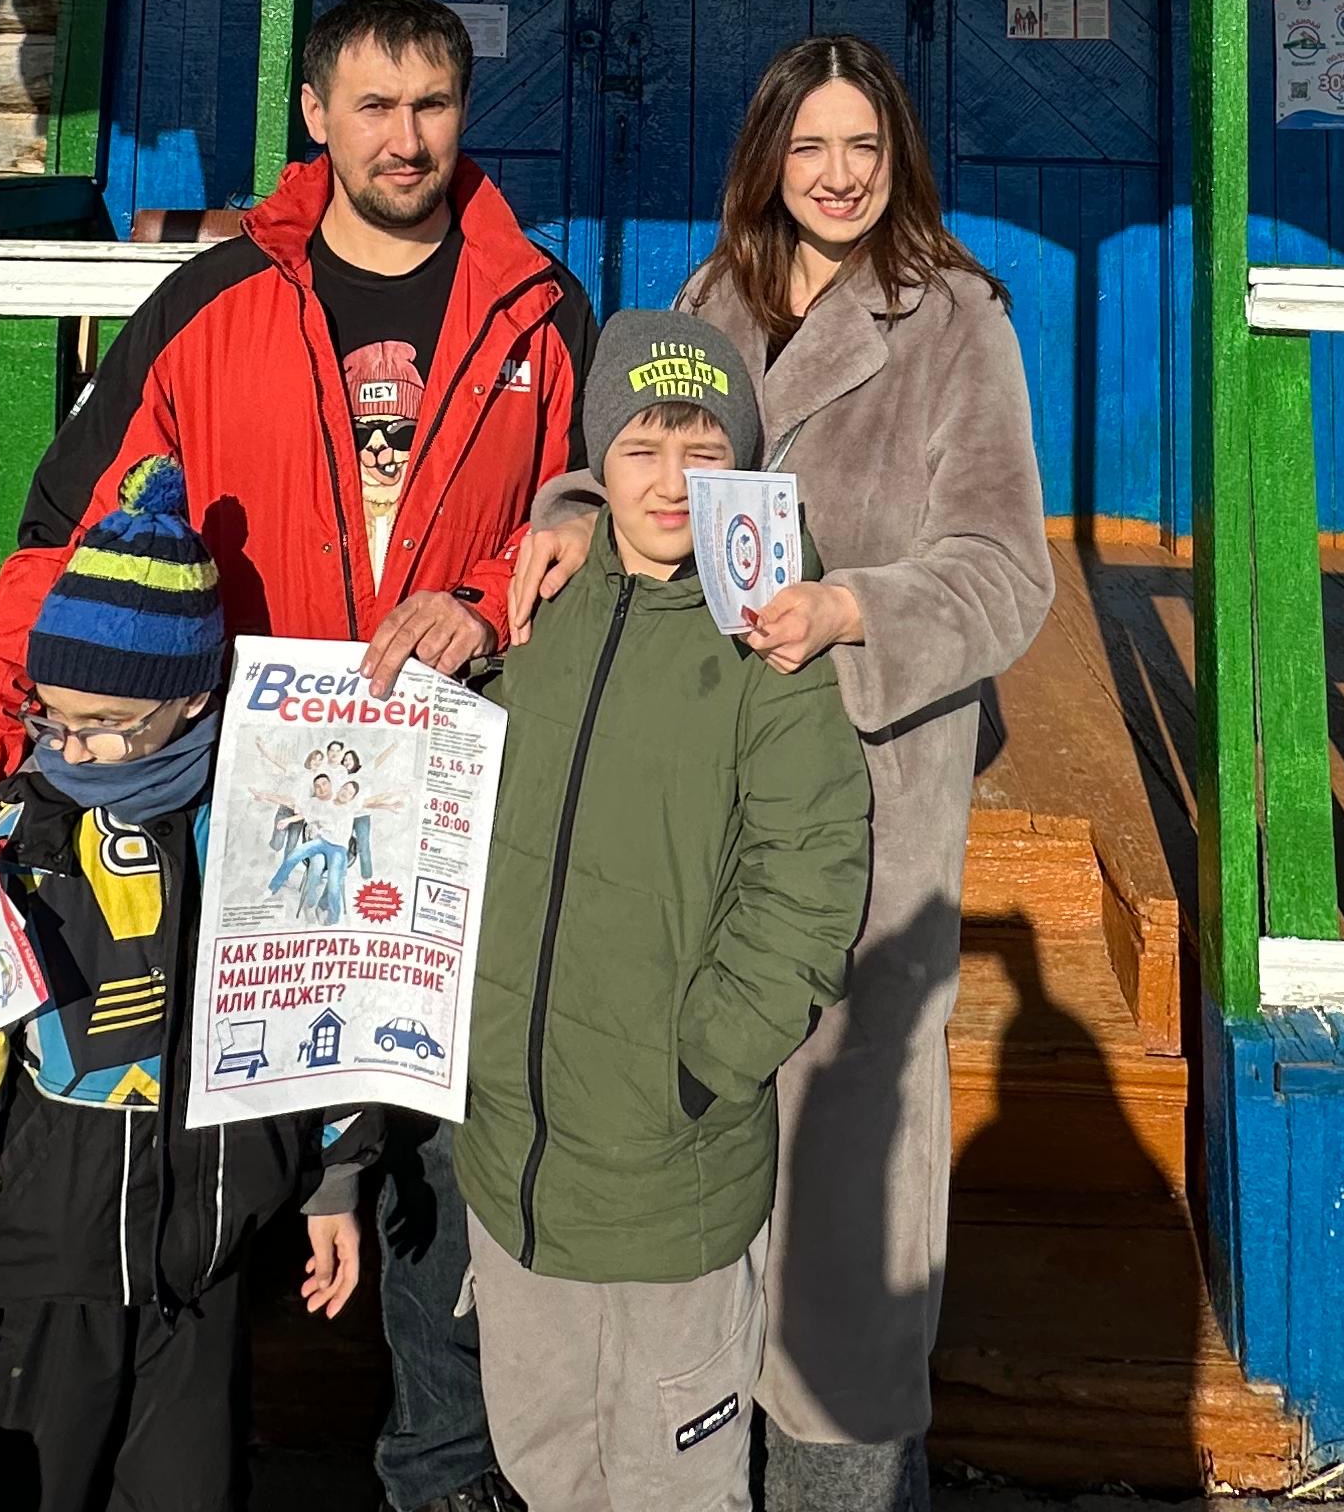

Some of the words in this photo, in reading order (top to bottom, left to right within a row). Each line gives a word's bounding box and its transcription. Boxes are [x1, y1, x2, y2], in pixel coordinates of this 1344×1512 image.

[651, 341, 706, 361] little
[363, 385, 394, 400] HEY
[656, 380, 703, 399] man
[279, 690, 430, 729] семьёй
[428, 755, 445, 771] 15,
[449, 759, 465, 775] 16,
[469, 763, 484, 776] 17
[429, 797, 459, 815] 8:00
[434, 813, 470, 833] 20:00
[420, 838, 429, 851] 6
[220, 942, 257, 964] КАК
[263, 938, 361, 960] ВЫИГРАТЬ
[366, 939, 456, 977] КВАРТИРУ,
[218, 962, 306, 989] МАШИНУ,
[311, 961, 445, 993] ПУТЕШЕСТВИЕ
[216, 990, 256, 1014] ИЛИ
[262, 984, 346, 1010] ГАДЖЕТ?
